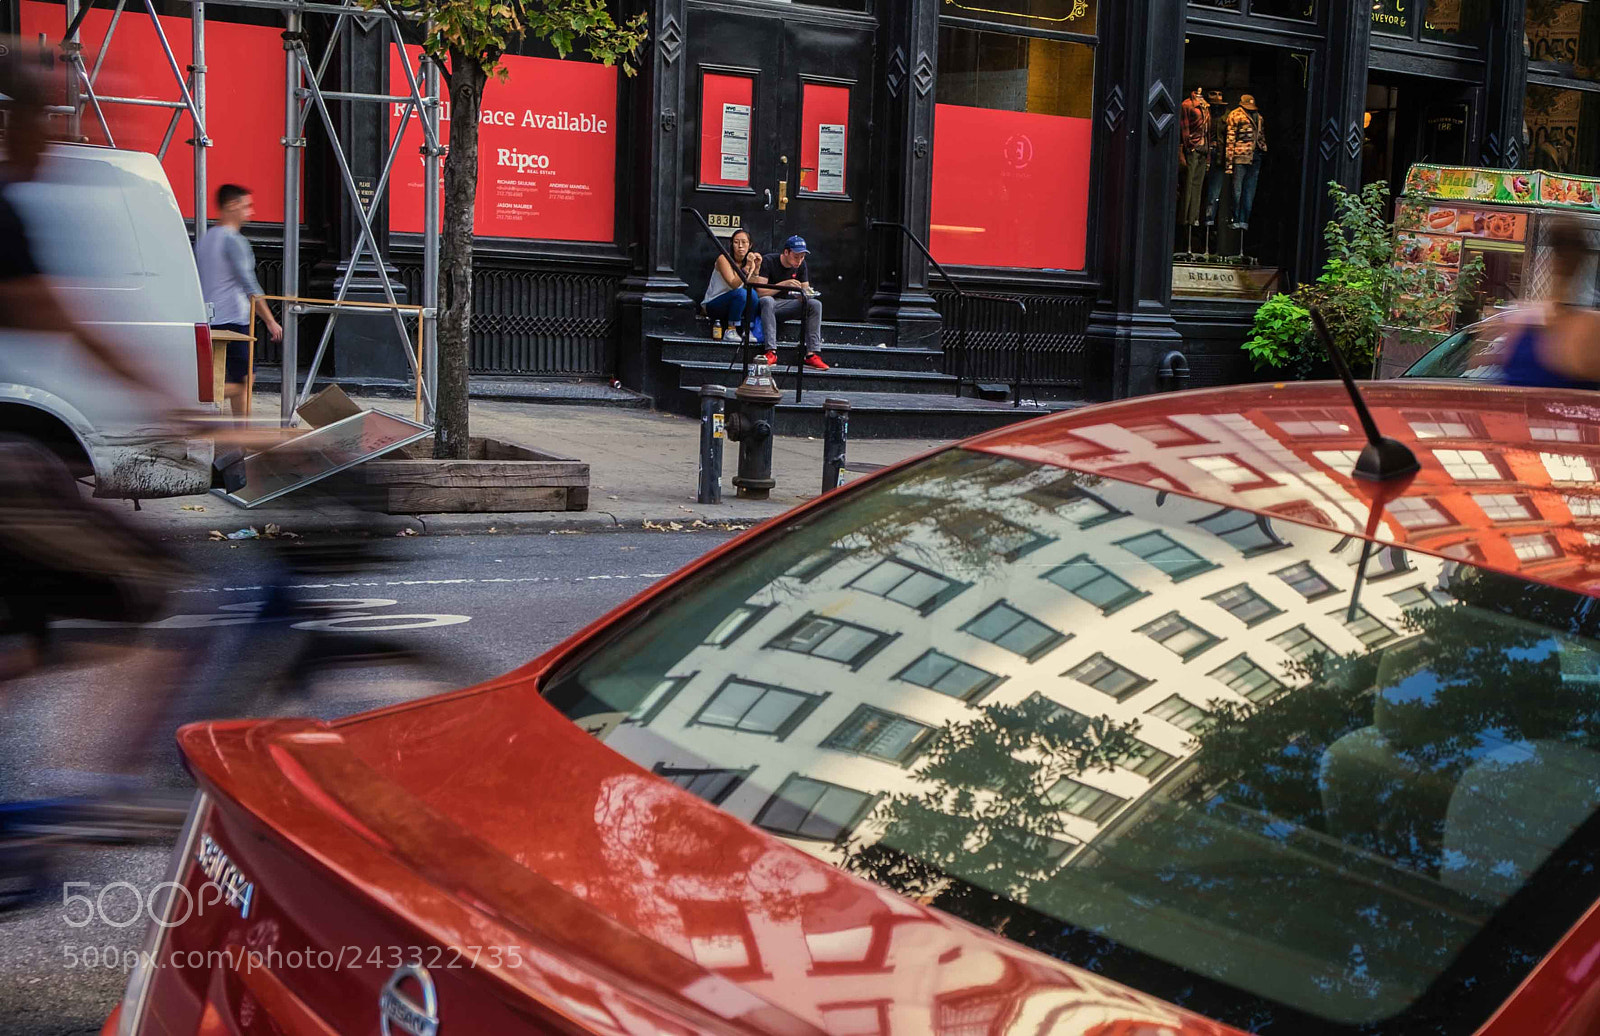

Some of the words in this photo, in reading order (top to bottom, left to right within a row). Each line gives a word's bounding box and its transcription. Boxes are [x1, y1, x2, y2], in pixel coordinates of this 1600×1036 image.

[521, 109, 608, 134] Available
[497, 148, 550, 174] Ripco
[709, 215, 729, 225] 383
[733, 216, 739, 226] A
